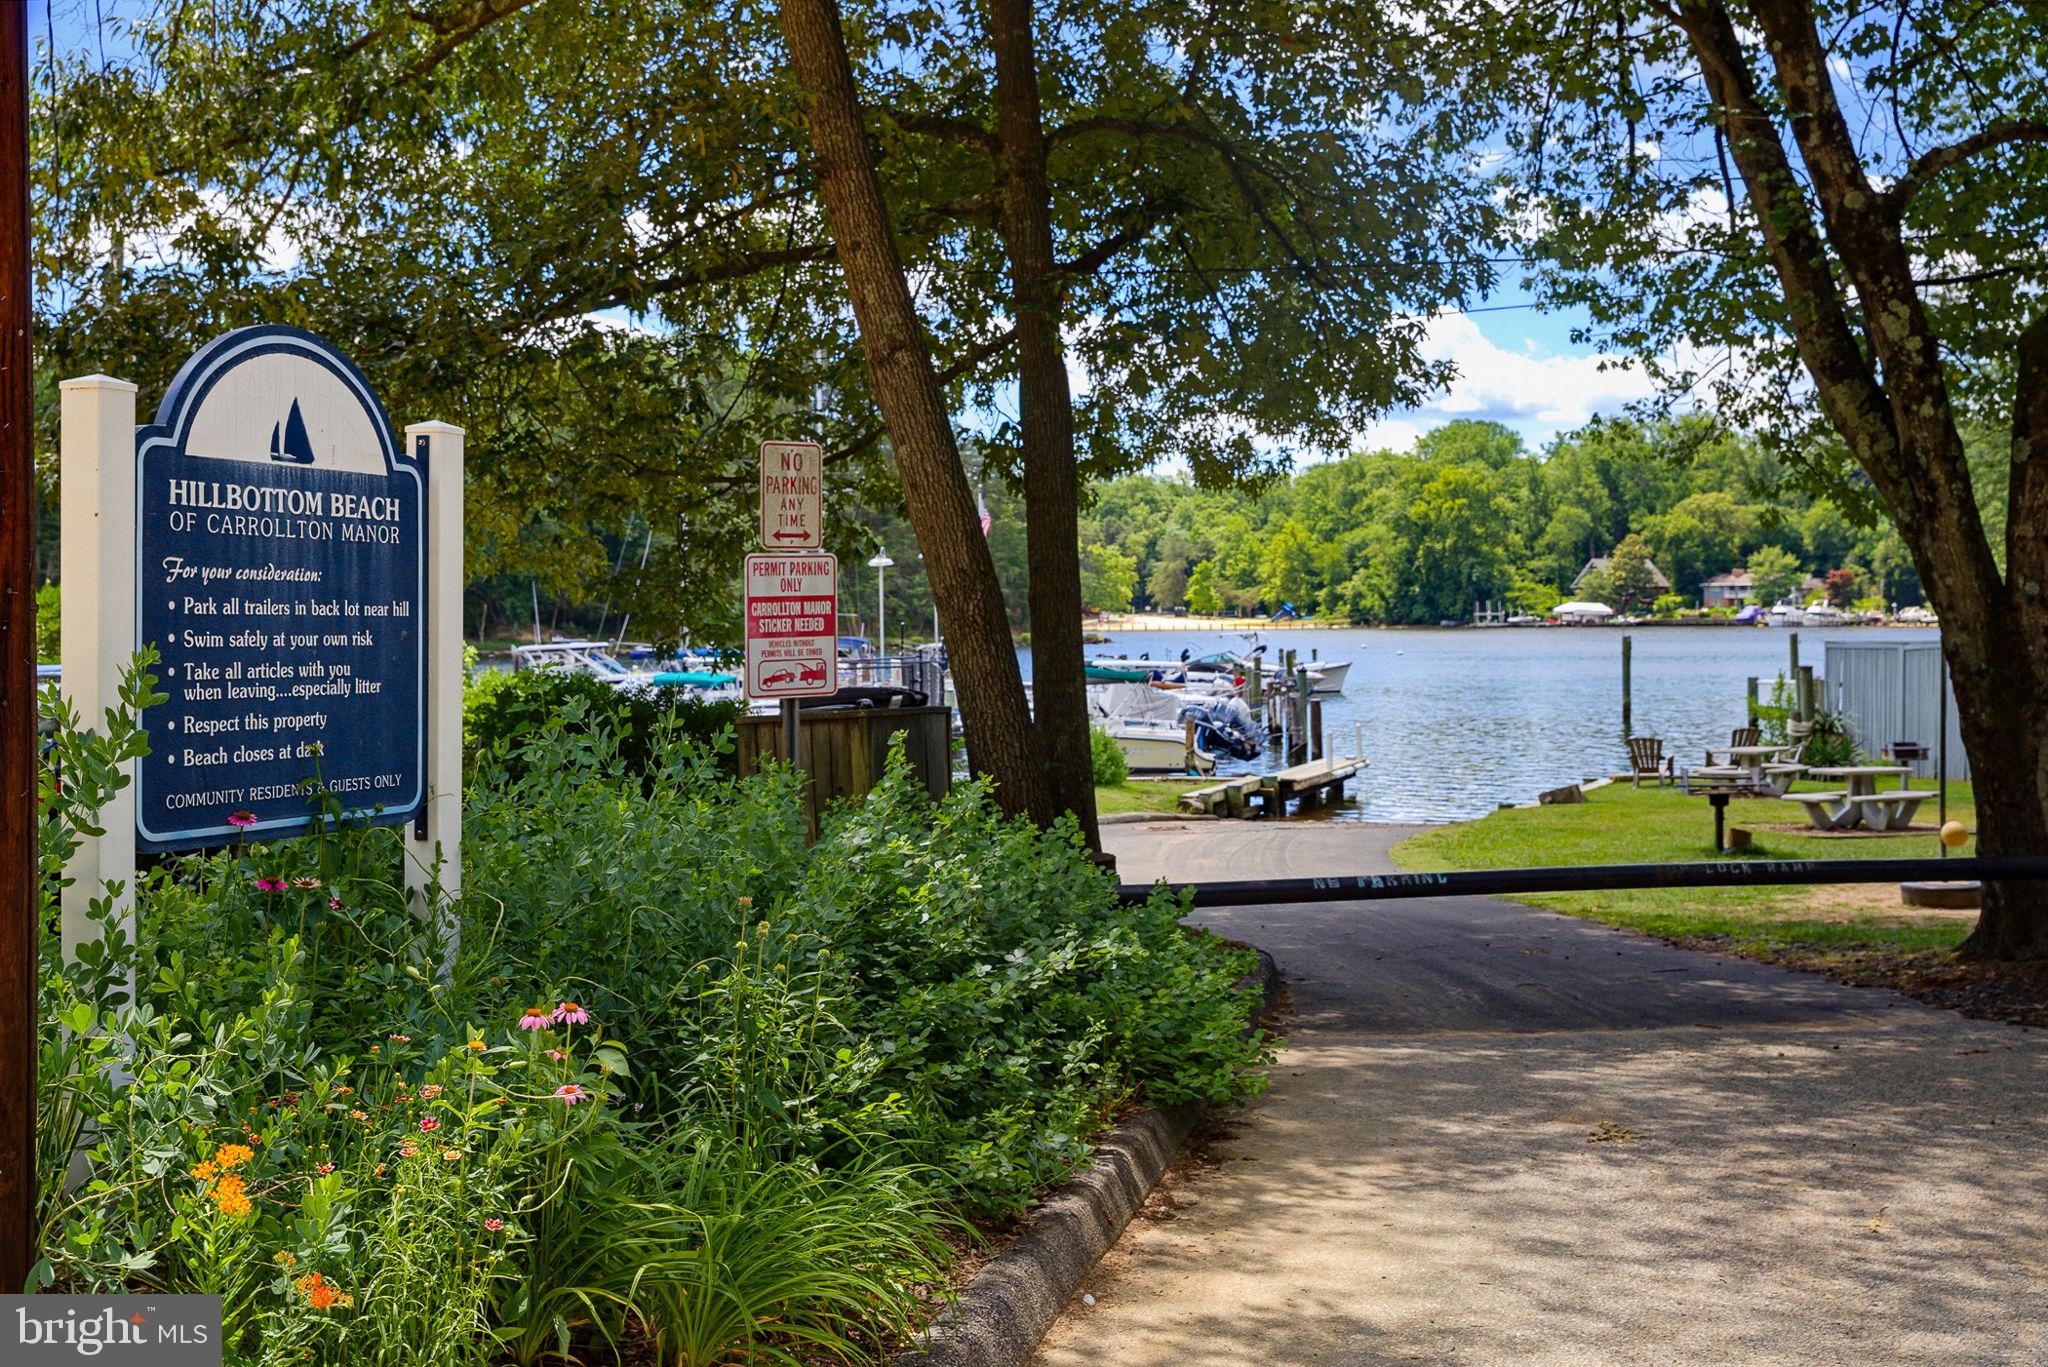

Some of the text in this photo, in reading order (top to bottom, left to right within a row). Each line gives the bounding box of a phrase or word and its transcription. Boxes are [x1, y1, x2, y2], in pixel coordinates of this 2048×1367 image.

[781, 453, 803, 471] NO
[766, 476, 818, 495] PARKING
[169, 479, 400, 521] HILLBOTTOM BEACH
[780, 498, 804, 511] ANY
[170, 511, 400, 544] OF CARROLLTON MANOR
[778, 514, 806, 527] TIME
[162, 556, 322, 585] For your consideration:
[753, 561, 830, 577] PERMIT PARKING
[780, 578, 803, 593] ONLY
[184, 596, 410, 617] Park all trailers in back lot near hill
[751, 600, 832, 616] CARROLLTON MANOR
[759, 617, 825, 633] STICKER NEEDED
[184, 629, 373, 650] Swim safely at your own risk
[184, 661, 351, 680] Take all articles with you
[184, 682, 222, 701] when
[355, 678, 382, 694] litter
[184, 711, 327, 736] Respect this property
[184, 741, 325, 767] Beach closes at dak
[166, 788, 245, 809] COMMUNITY
[329, 776, 371, 793] GUESTS
[374, 774, 402, 789] ONLY
